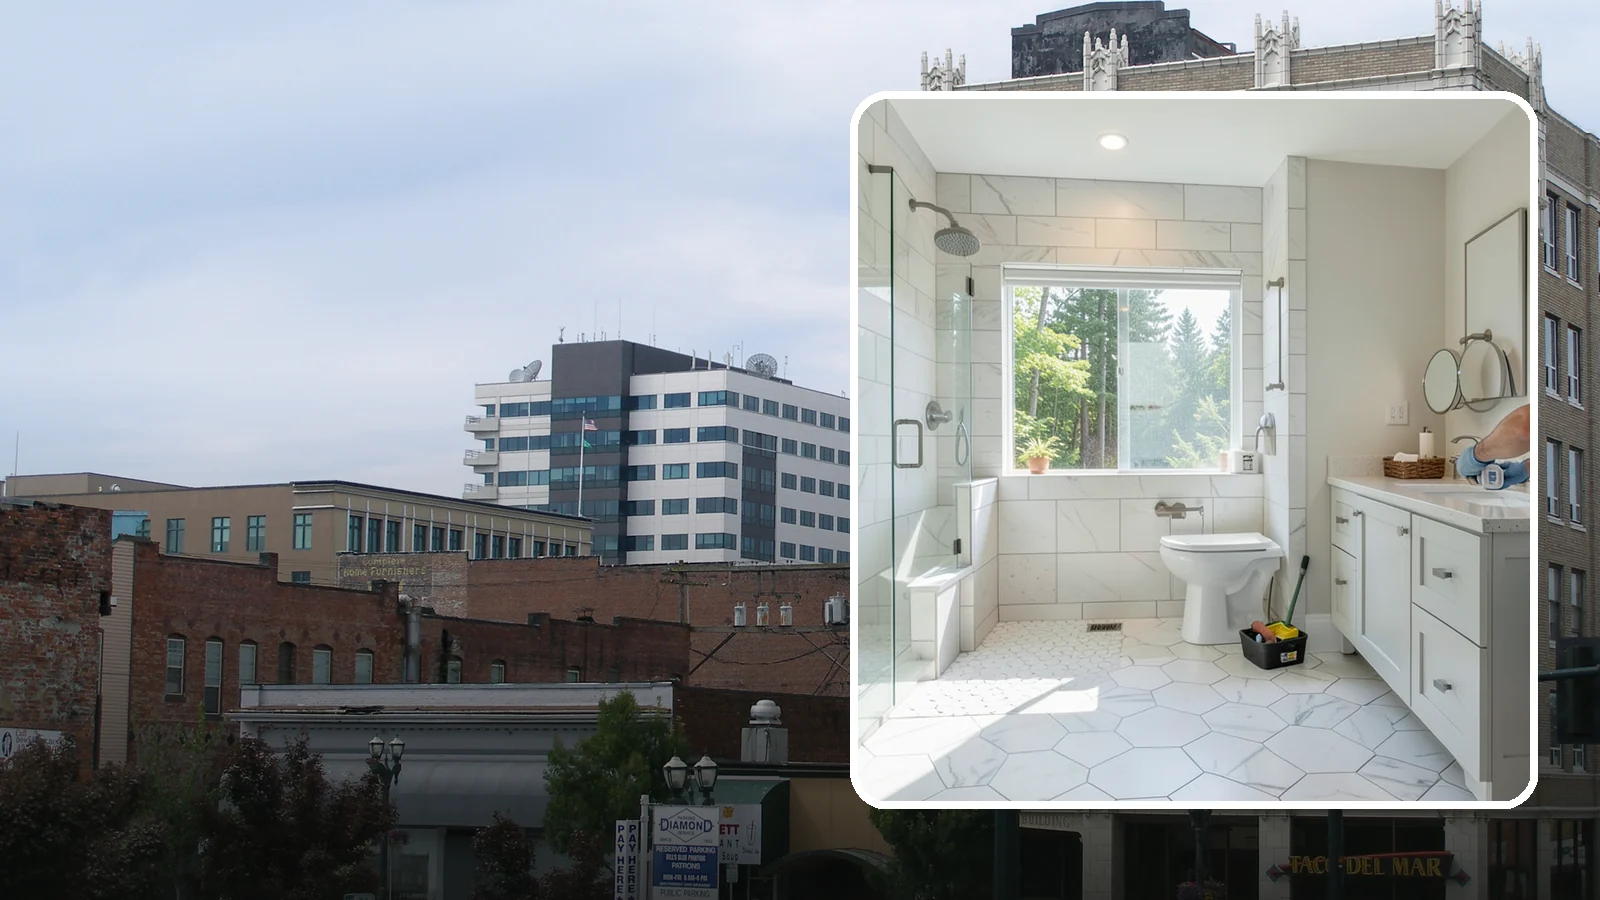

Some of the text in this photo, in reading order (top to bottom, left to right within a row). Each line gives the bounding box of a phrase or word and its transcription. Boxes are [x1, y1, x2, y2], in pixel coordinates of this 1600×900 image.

[370, 566, 427, 577] Furnishers
[660, 818, 713, 832] DIAMOND
[1022, 815, 1069, 828] BUILDING
[656, 845, 716, 854] RESERVED PARKING
[721, 851, 739, 862] Soup
[671, 862, 701, 870] PATRONS
[1289, 855, 1442, 877] TAC DEL MAR
[660, 888, 710, 898] PUBLIC PARKING
